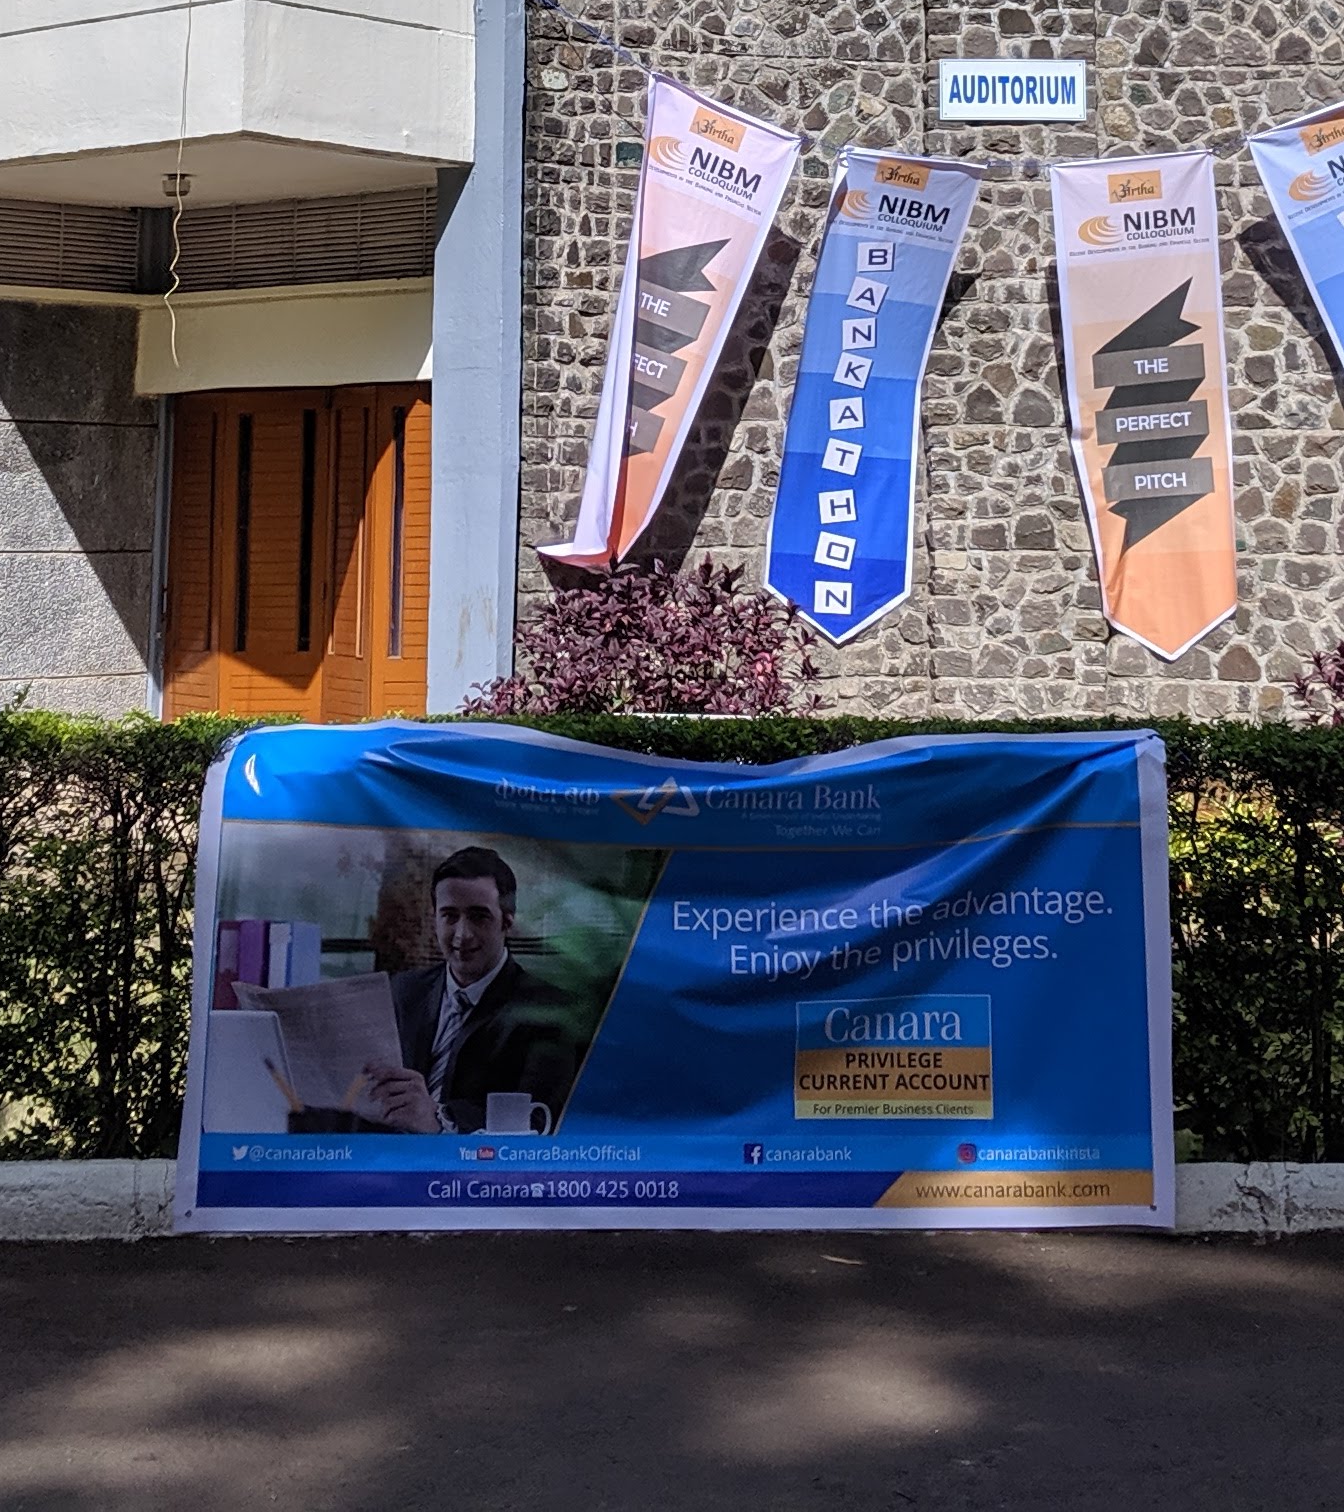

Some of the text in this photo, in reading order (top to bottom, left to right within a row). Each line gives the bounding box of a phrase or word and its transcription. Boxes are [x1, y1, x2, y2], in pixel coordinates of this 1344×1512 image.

[948, 74, 1076, 105] AUDITORIUM
[689, 147, 762, 193] NIBM
[688, 166, 754, 201] COLLOQUIUM
[878, 194, 951, 225] NIBM
[877, 213, 944, 233] COLLOQUIUM
[1123, 206, 1196, 233] NIBM
[1126, 226, 1195, 241] COLLOQUIUM
[640, 292, 672, 317] THE
[633, 353, 667, 379] FECT
[1133, 357, 1169, 375] THE
[1115, 411, 1192, 433] PERFECT
[1134, 472, 1187, 491] PITCH
[706, 783, 881, 809] Canara Bank
[857, 825, 881, 836] Can
[672, 887, 1114, 940] Experience the advantage.
[730, 929, 1058, 983] Enjoy the privileges.
[824, 1006, 963, 1043] Canara
[845, 1052, 943, 1069] PRIVILEGE
[799, 1074, 990, 1091] CURRENT ACCOUNT
[813, 1104, 974, 1115] For Premier Business Clients
[249, 1145, 352, 1163] @canarabank
[498, 1145, 641, 1162] CanaraBankOfficial
[765, 1146, 852, 1162] canarabank
[978, 1146, 1100, 1161] canarabankinsta
[428, 1180, 679, 1199] Call Canara 1800 425 0018
[916, 1181, 1110, 1198] www.canarabank.com
